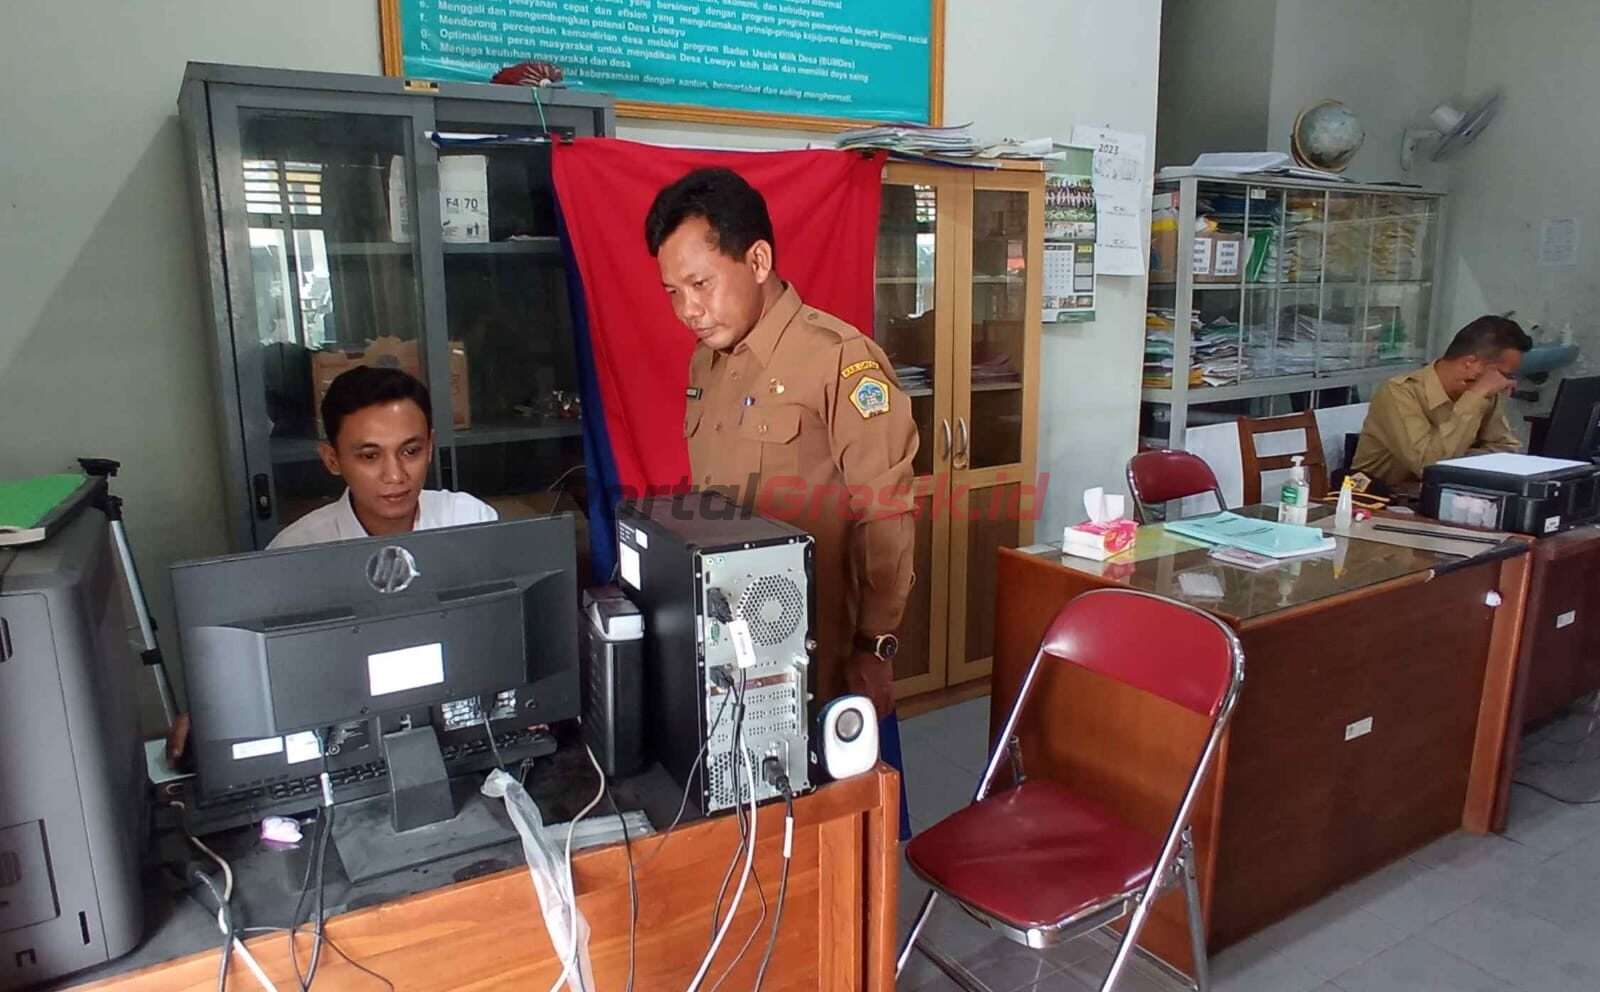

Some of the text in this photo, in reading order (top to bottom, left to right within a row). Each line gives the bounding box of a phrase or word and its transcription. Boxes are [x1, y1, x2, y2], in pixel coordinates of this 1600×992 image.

[438, 0, 486, 15] Menggali
[488, 7, 507, 16] dan
[508, 9, 591, 26] mengembangkan
[592, 18, 626, 30] potensi
[627, 21, 650, 33] Desa
[651, 24, 687, 38] Lowayu
[563, 2, 589, 13] cepat
[594, 6, 613, 16] dan
[618, 9, 648, 19] efisien
[653, 13, 675, 24] yang
[705, 6, 737, 18] dengan
[741, 12, 776, 23] program
[778, 17, 810, 28] program
[439, 14, 497, 31] Mendorong
[503, 22, 557, 36] percepatan
[561, 28, 618, 42] kemandirian
[621, 35, 644, 45] desa
[683, 42, 719, 54] program
[723, 45, 749, 57] Badan
[752, 49, 778, 60] Usaha
[798, 54, 818, 65] Desa
[439, 28, 504, 43] Optimalisasi
[507, 36, 536, 47] peran
[540, 39, 594, 52] masyarakat
[597, 45, 623, 55] untuk
[626, 48, 677, 61] menjadikan
[680, 52, 702, 64] Desa
[704, 56, 737, 69] Lowayu
[739, 59, 760, 71] lebih
[762, 62, 780, 73] baik
[781, 64, 797, 74] dan
[440, 42, 483, 56] Menjaga
[485, 46, 531, 60] keutuhan
[533, 52, 589, 65] masyarakat
[590, 56, 608, 66] dan
[609, 58, 632, 69] desa
[580, 66, 641, 82] kebersamaan
[643, 74, 676, 86] dengan
[763, 85, 779, 95] dan
[1098, 143, 1120, 155] 2023
[446, 198, 479, 209] F4 70
